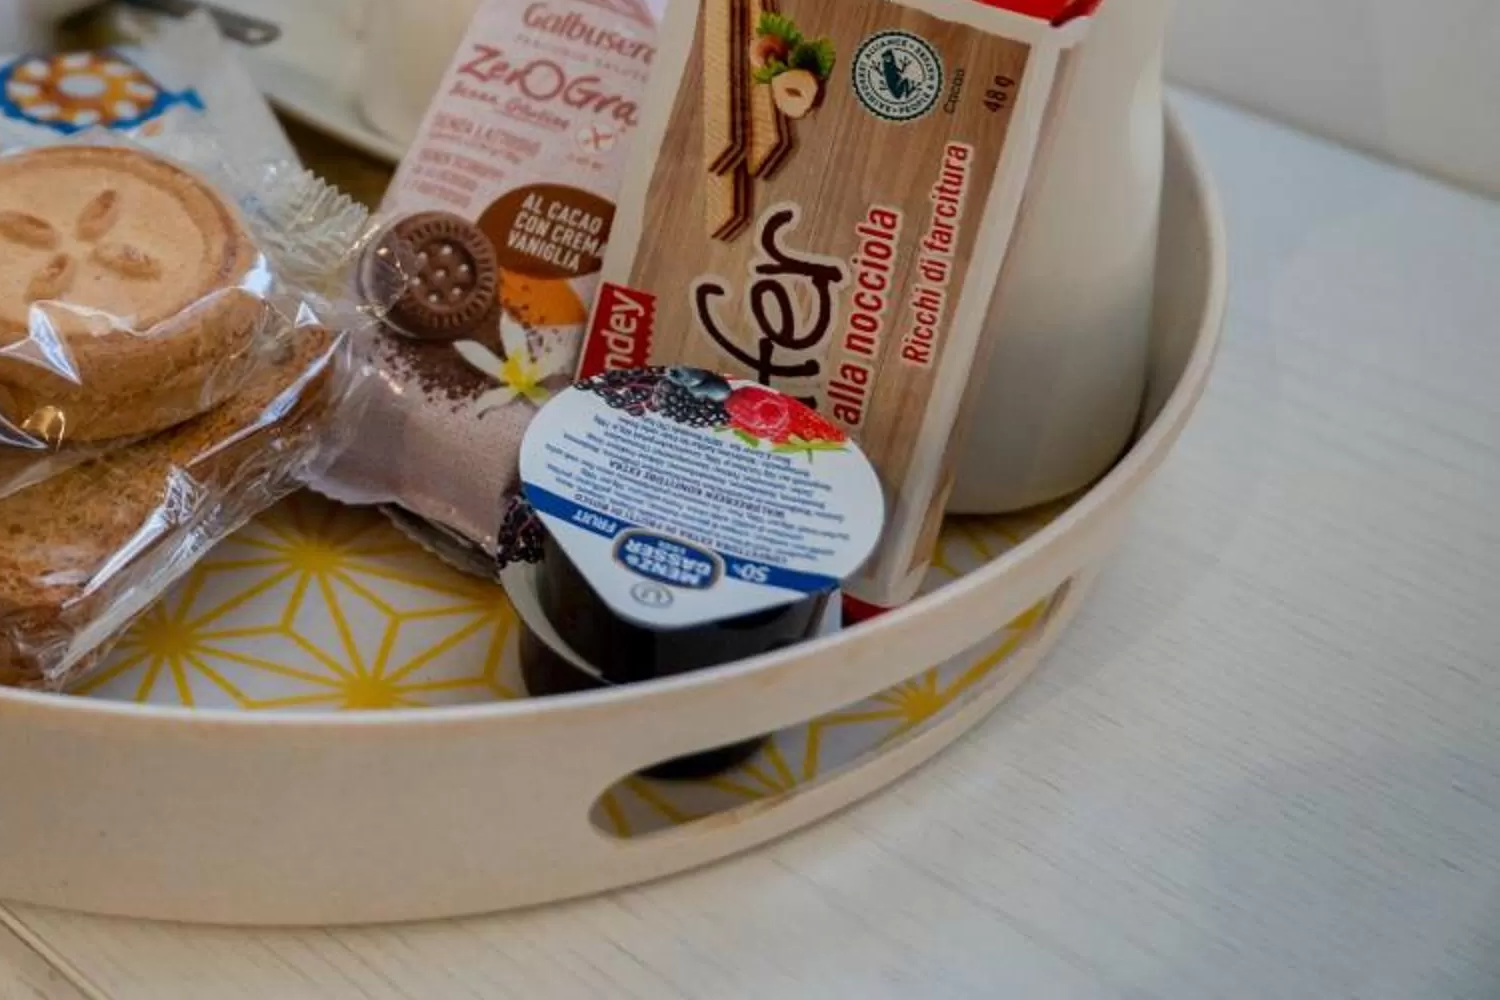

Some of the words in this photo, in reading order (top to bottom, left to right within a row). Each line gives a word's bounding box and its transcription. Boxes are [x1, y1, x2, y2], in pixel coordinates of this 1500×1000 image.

[513, 211, 551, 237] CON
[521, 192, 544, 214] AL
[547, 200, 603, 235] CACAO
[923, 143, 969, 254] farcitura
[507, 228, 581, 273] VANIGLIA
[922, 256, 950, 285] di
[696, 209, 842, 408] fer
[842, 206, 900, 357] nocciola
[901, 287, 943, 365] Ricchi
[827, 362, 870, 427] alla
[571, 509, 617, 535] FRUIT
